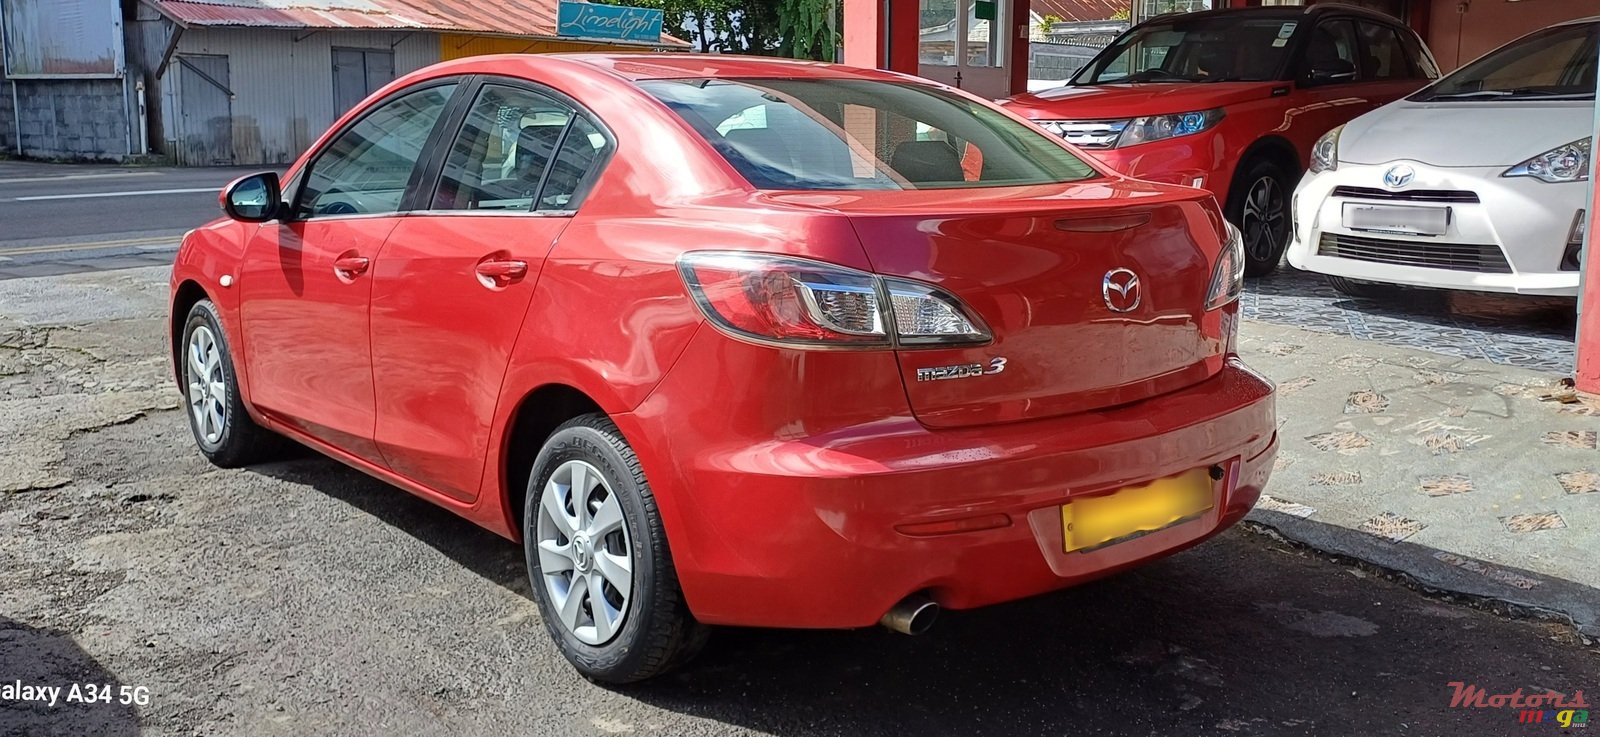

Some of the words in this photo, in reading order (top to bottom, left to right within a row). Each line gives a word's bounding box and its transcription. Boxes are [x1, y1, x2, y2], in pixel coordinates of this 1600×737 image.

[562, 6, 660, 38] Limelight
[917, 364, 983, 381] mazda
[984, 357, 1008, 375] 3
